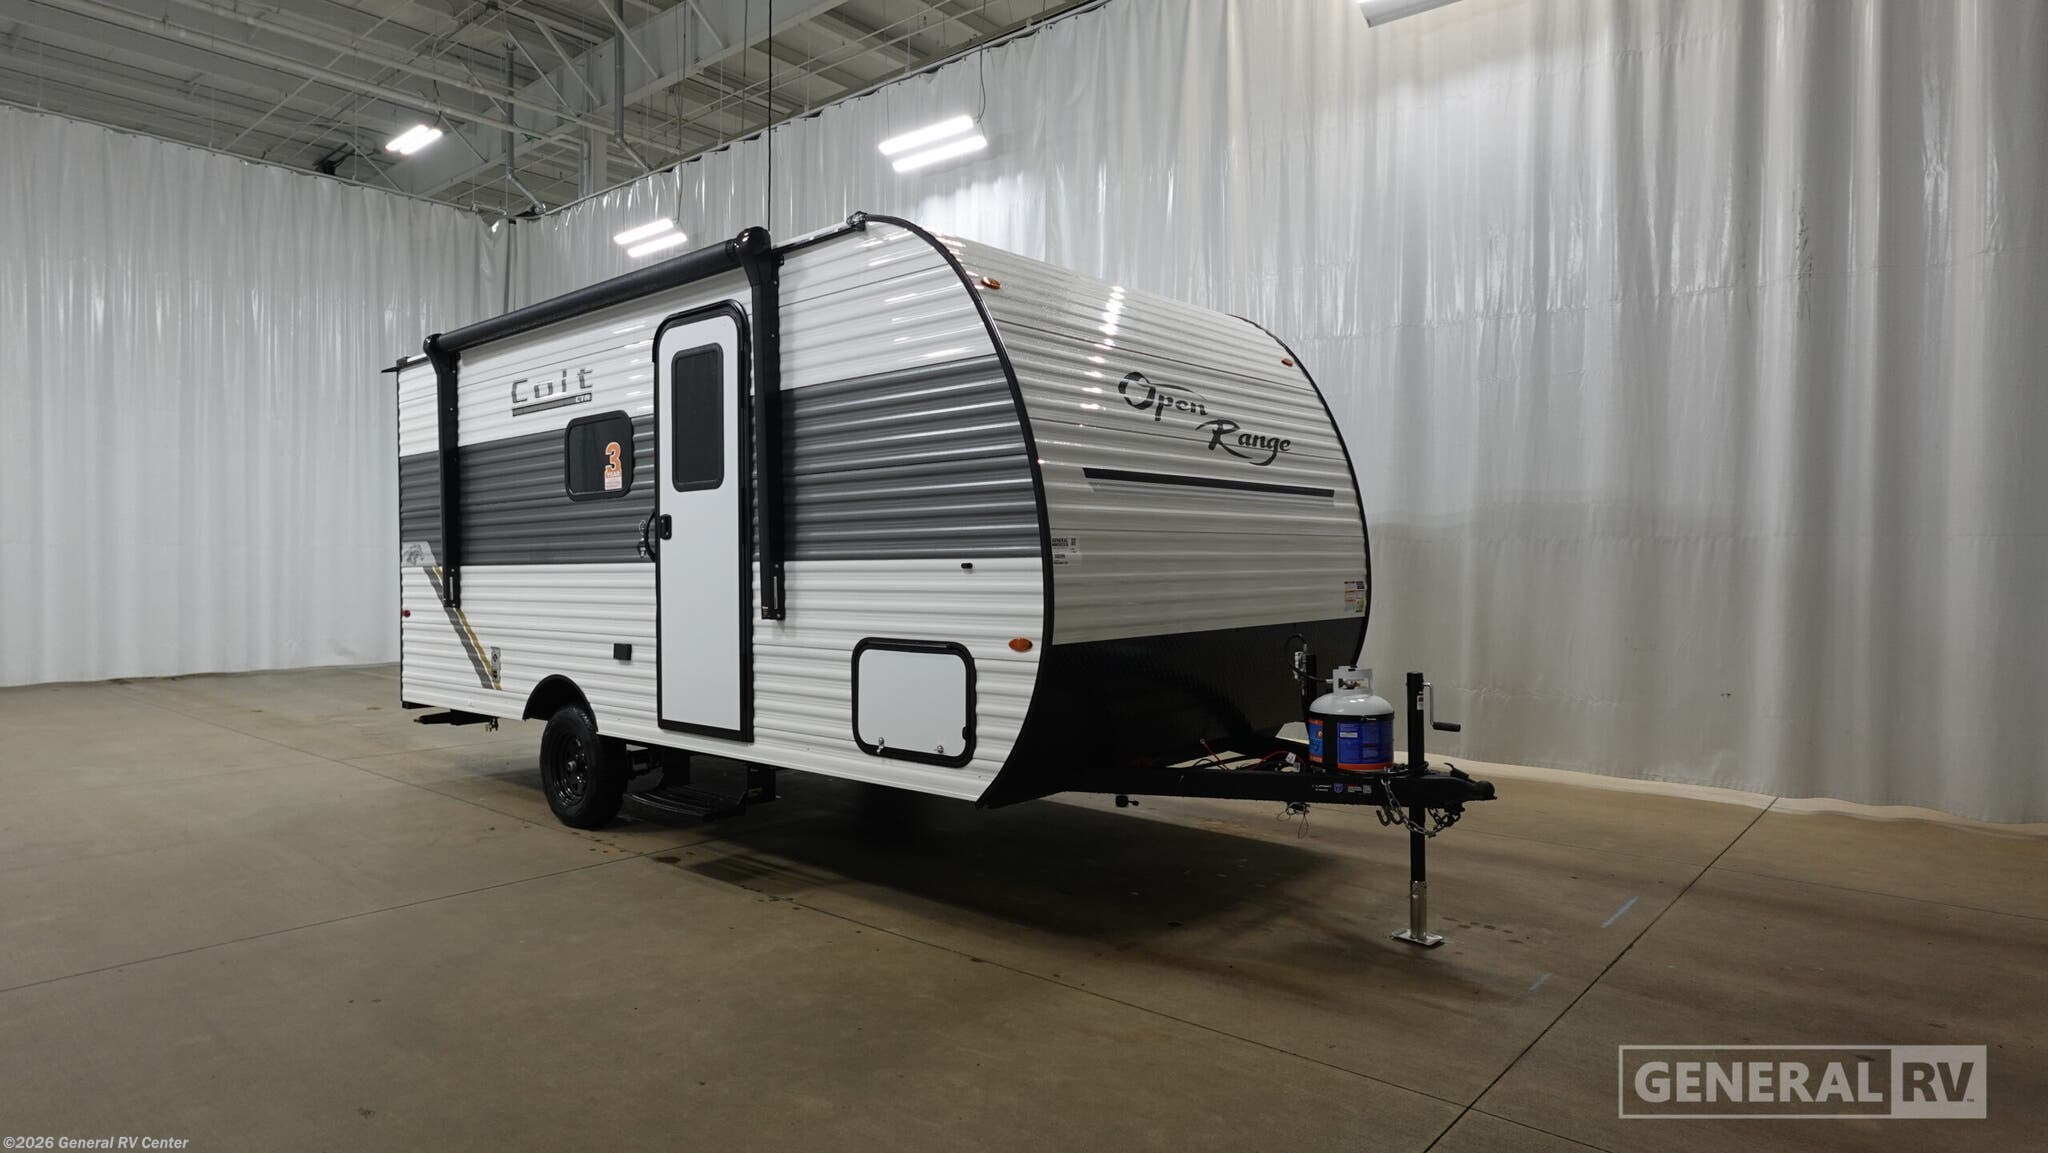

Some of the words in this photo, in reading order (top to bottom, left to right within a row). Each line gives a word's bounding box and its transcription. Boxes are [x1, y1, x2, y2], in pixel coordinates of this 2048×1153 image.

[511, 368, 592, 403] Colt
[1118, 371, 1208, 422] Open
[605, 441, 622, 473] 3
[1195, 419, 1291, 466] Range
